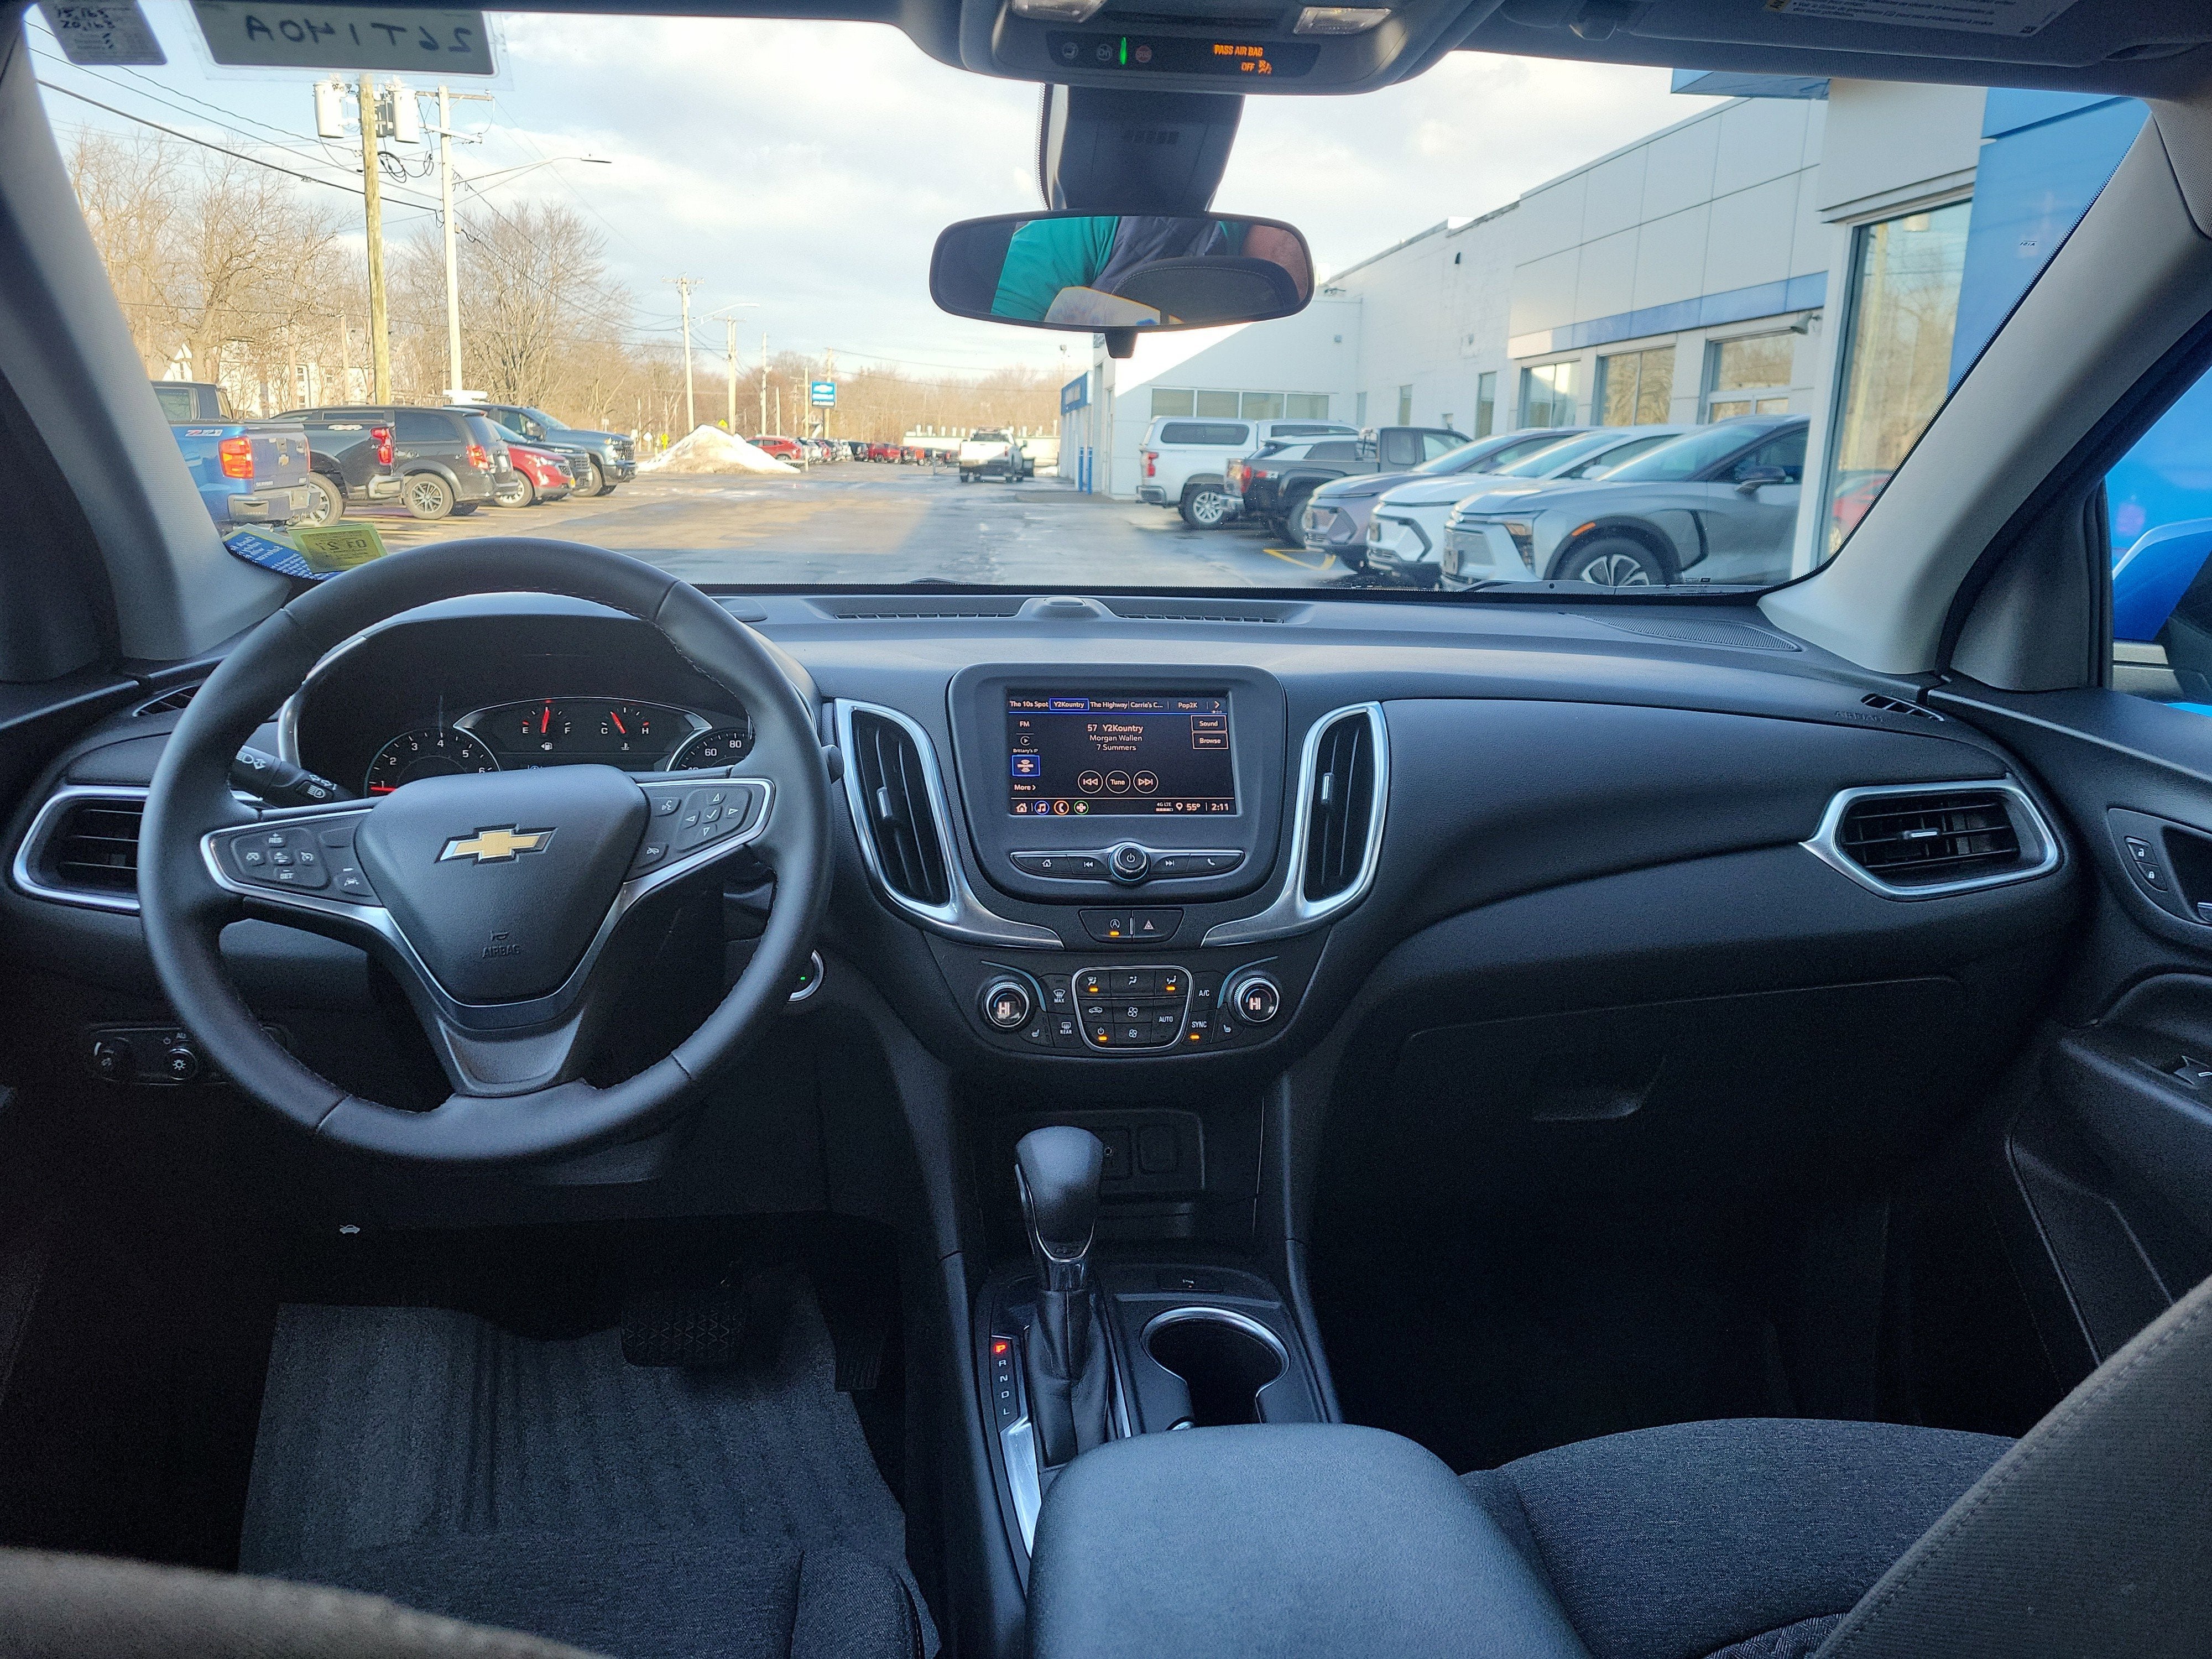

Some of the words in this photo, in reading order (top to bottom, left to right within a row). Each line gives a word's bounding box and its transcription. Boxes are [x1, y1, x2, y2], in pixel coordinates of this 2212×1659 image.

[1214, 44, 1234, 55] PASS
[1234, 46, 1248, 56] AIR
[1248, 46, 1263, 58] BAG
[1241, 61, 1255, 71] OFF
[1102, 724, 1143, 733] Y2Kountry
[705, 748, 717, 757] 60
[1211, 803, 1229, 811] 2:11
[1249, 997, 1261, 1010] HI
[998, 1001, 1011, 1016] HI
[995, 1344, 1006, 1353] P
[1000, 1374, 1008, 1383] N
